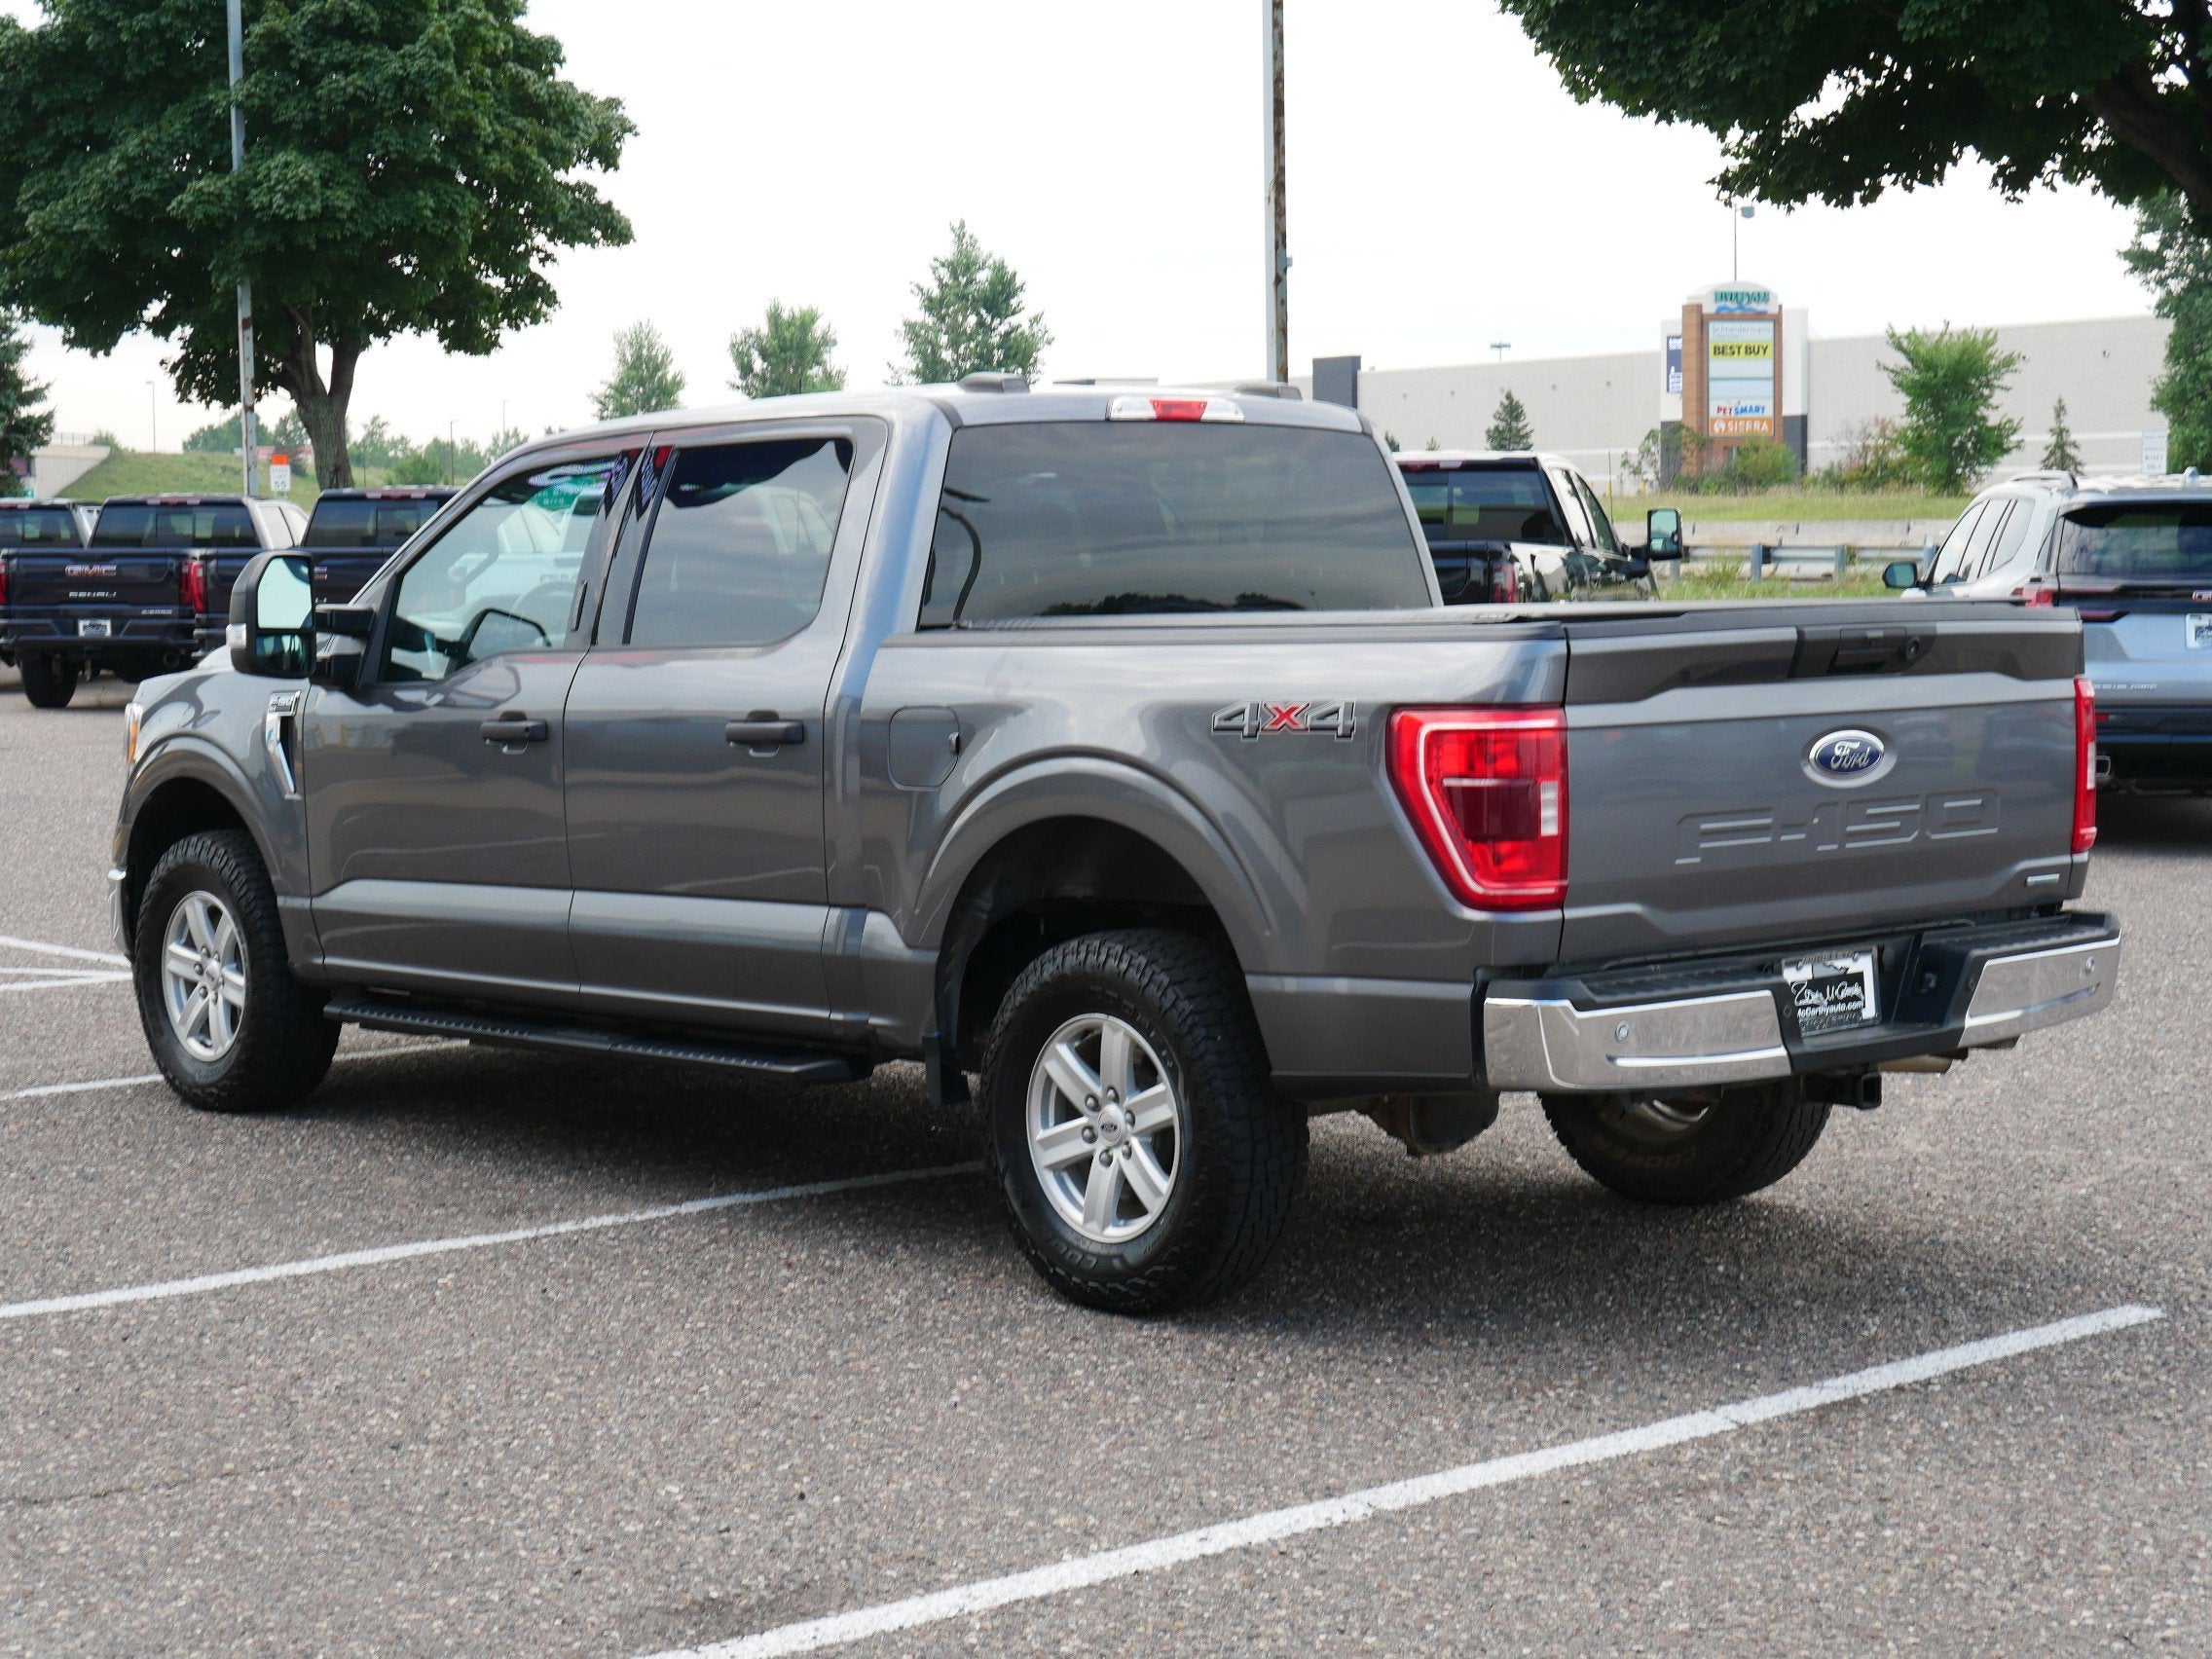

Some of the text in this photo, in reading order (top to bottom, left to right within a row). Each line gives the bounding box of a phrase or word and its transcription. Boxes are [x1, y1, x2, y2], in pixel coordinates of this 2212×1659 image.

[1714, 344, 1769, 356] BEST BUY
[1727, 420, 1770, 433] SIERRA
[64, 565, 117, 578] GMC
[1830, 740, 1871, 771] Ford
[1675, 787, 2001, 866] F-150
